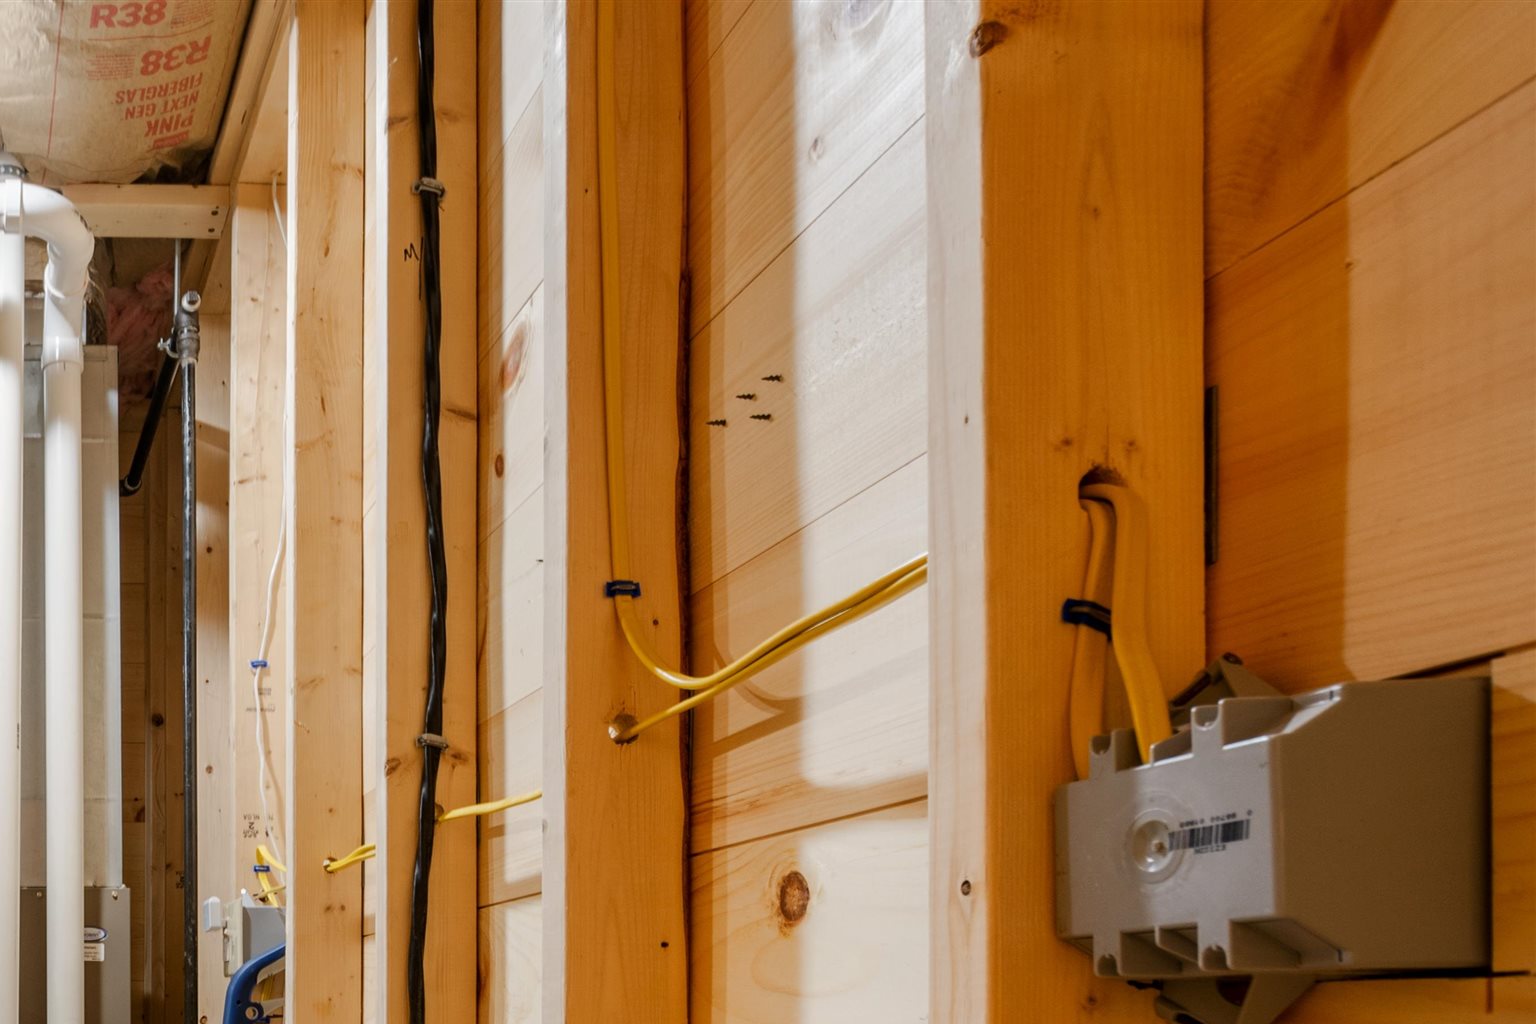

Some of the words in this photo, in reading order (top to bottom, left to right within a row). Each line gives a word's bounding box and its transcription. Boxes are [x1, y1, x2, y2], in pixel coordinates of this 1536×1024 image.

[89, 0, 168, 28] R38
[140, 34, 212, 76] R38
[115, 72, 203, 104] FIBERGLAS
[125, 103, 156, 120] GEN
[161, 91, 199, 114] NEXT
[144, 113, 194, 137] PINK
